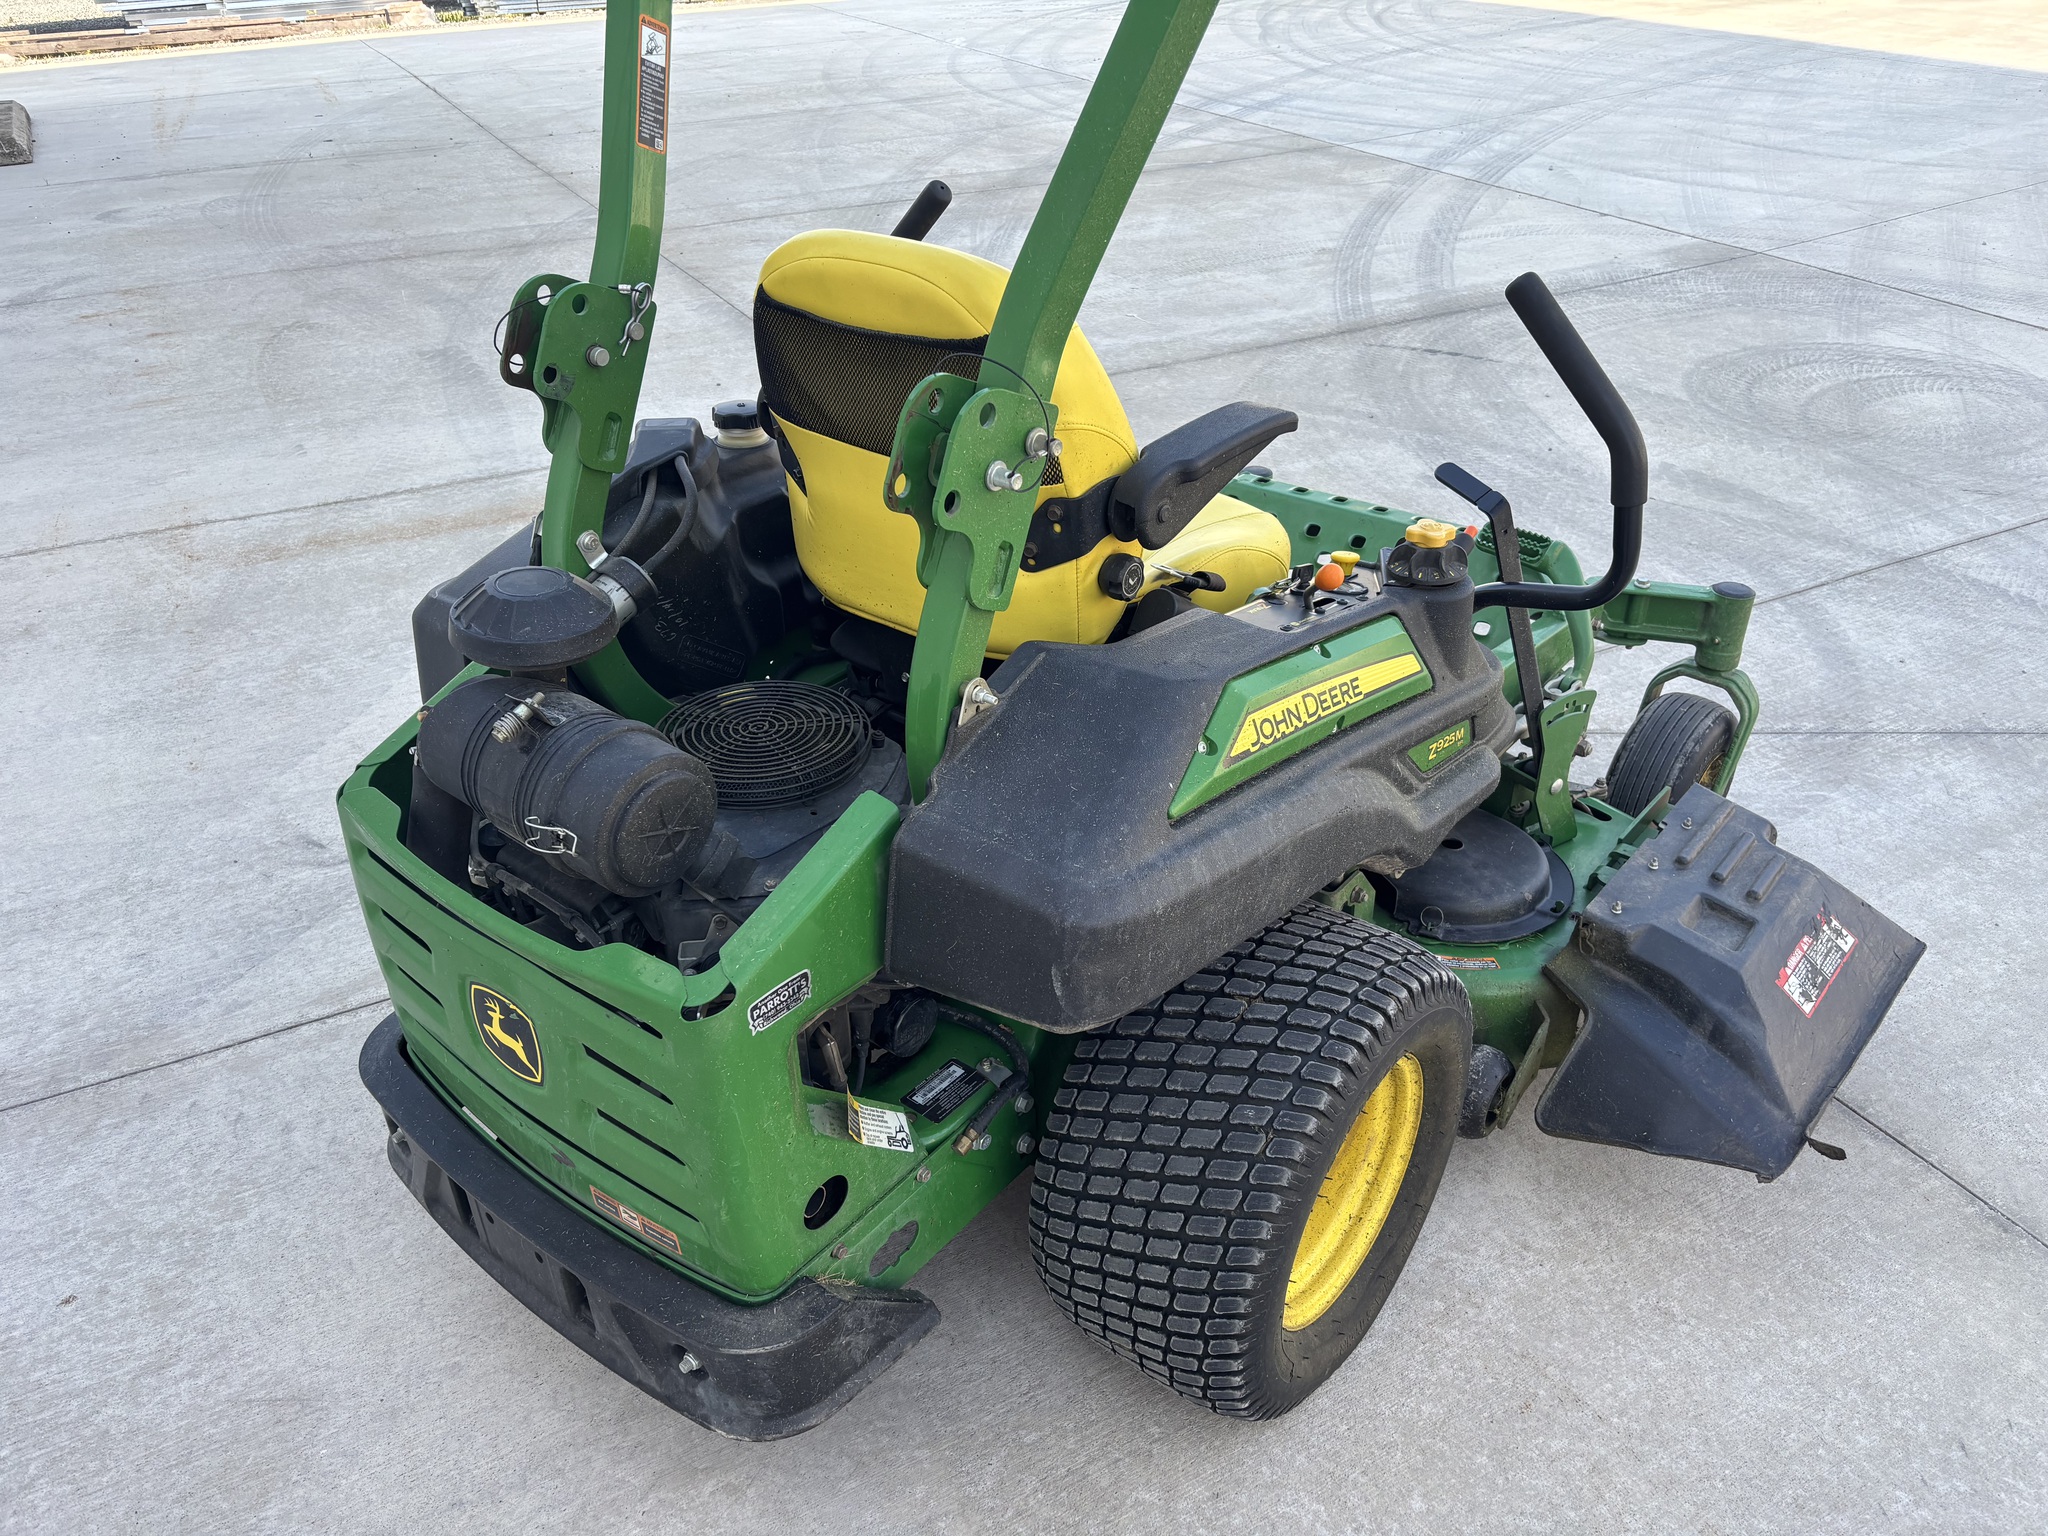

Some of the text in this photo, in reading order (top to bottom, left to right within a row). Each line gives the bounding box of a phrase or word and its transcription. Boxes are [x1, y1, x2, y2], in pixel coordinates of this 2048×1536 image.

[1250, 677, 1363, 747] JOHN DEERE
[1428, 727, 1464, 760] Z925M
[1787, 947, 1804, 970] DANGER
[752, 978, 807, 1020] PARROTT'S
[757, 992, 777, 1008] Another
[778, 986, 788, 994] One
